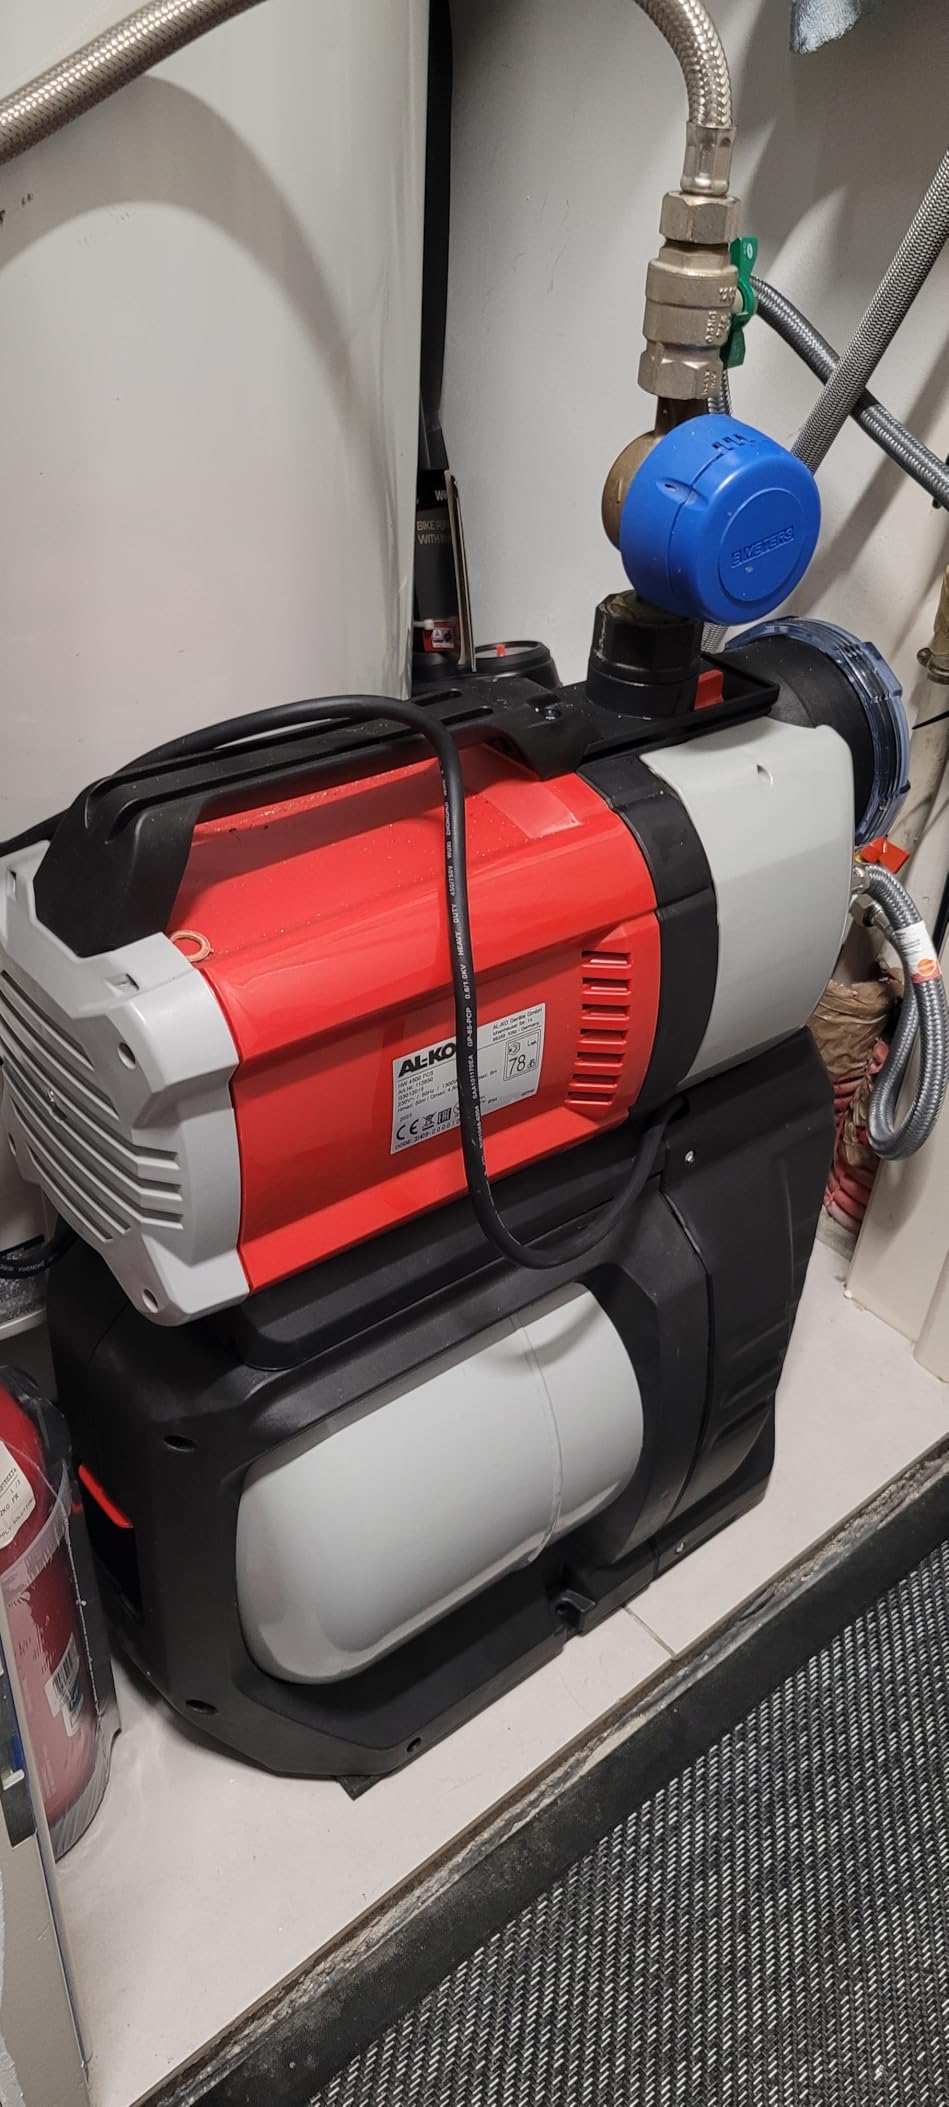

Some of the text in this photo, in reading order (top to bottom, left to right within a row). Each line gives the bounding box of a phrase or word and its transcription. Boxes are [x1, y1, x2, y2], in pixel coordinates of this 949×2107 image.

[416, 520, 434, 531] BIKE
[417, 534, 441, 545] WITH
[451, 903, 460, 924] DUTY
[455, 931, 465, 956] HEAVY
[460, 963, 471, 1000] 0.6/1.0KV
[398, 1042, 457, 1078] AL-KO
[508, 1054, 526, 1076] 78
[409, 1075, 422, 1084] 4500
